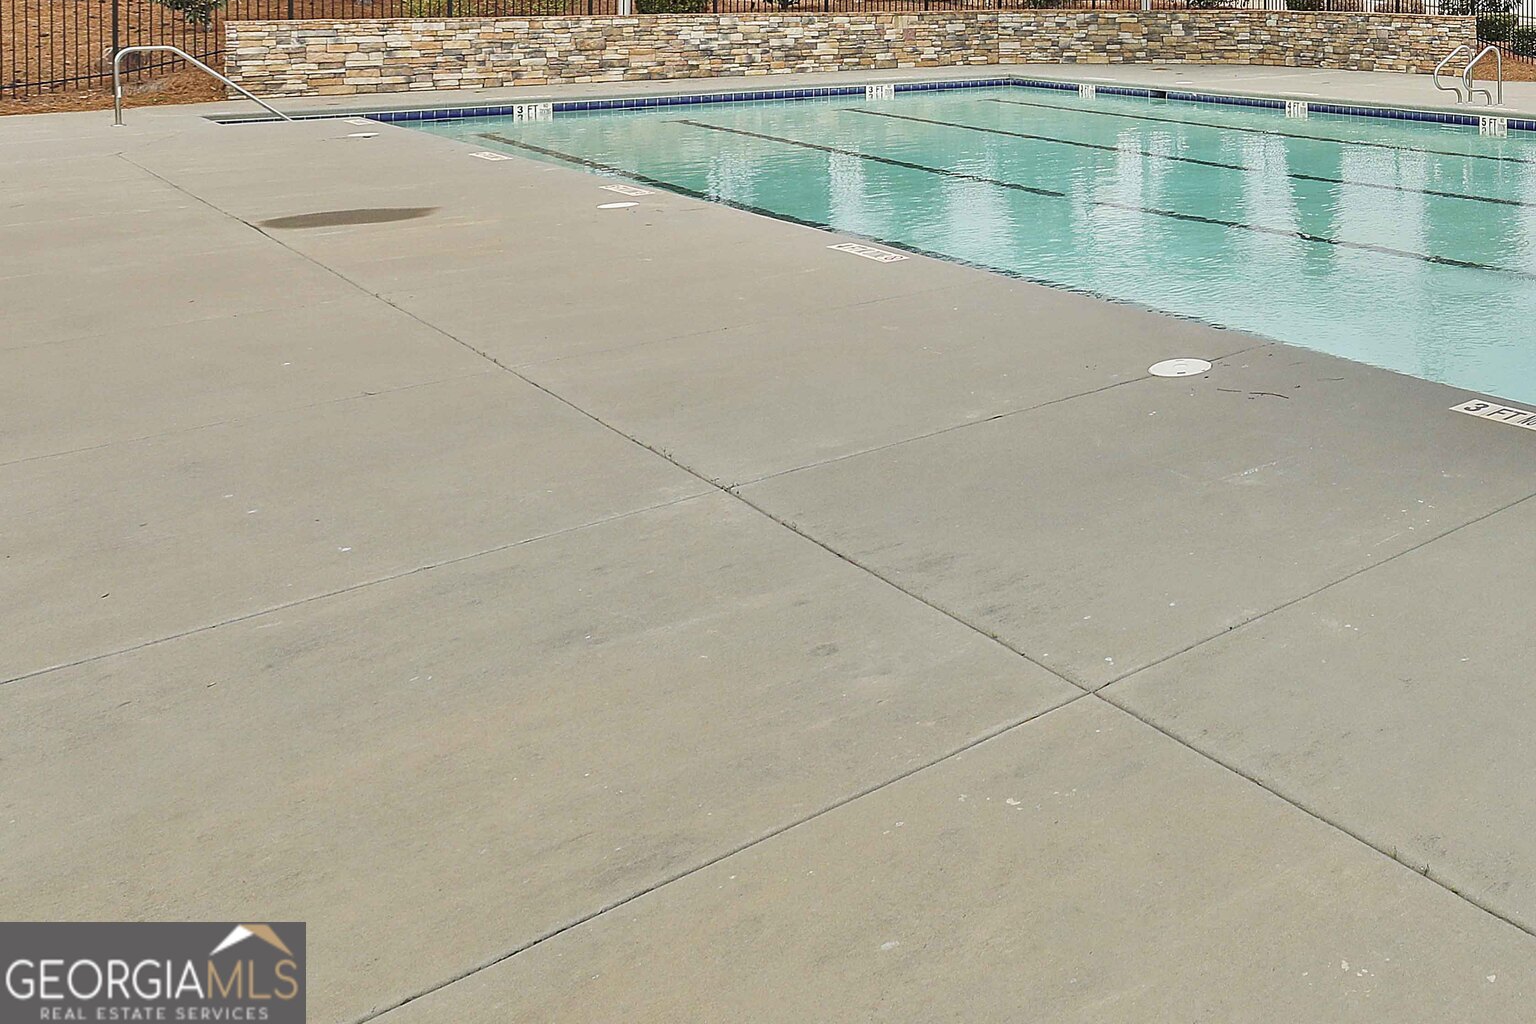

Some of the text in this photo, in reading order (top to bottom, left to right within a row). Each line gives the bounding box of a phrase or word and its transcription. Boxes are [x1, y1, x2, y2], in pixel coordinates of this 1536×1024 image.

[517, 106, 523, 114] 3
[528, 105, 538, 114] FT
[1481, 117, 1487, 127] 5
[1464, 403, 1490, 412] 3
[1486, 408, 1527, 421] FT
